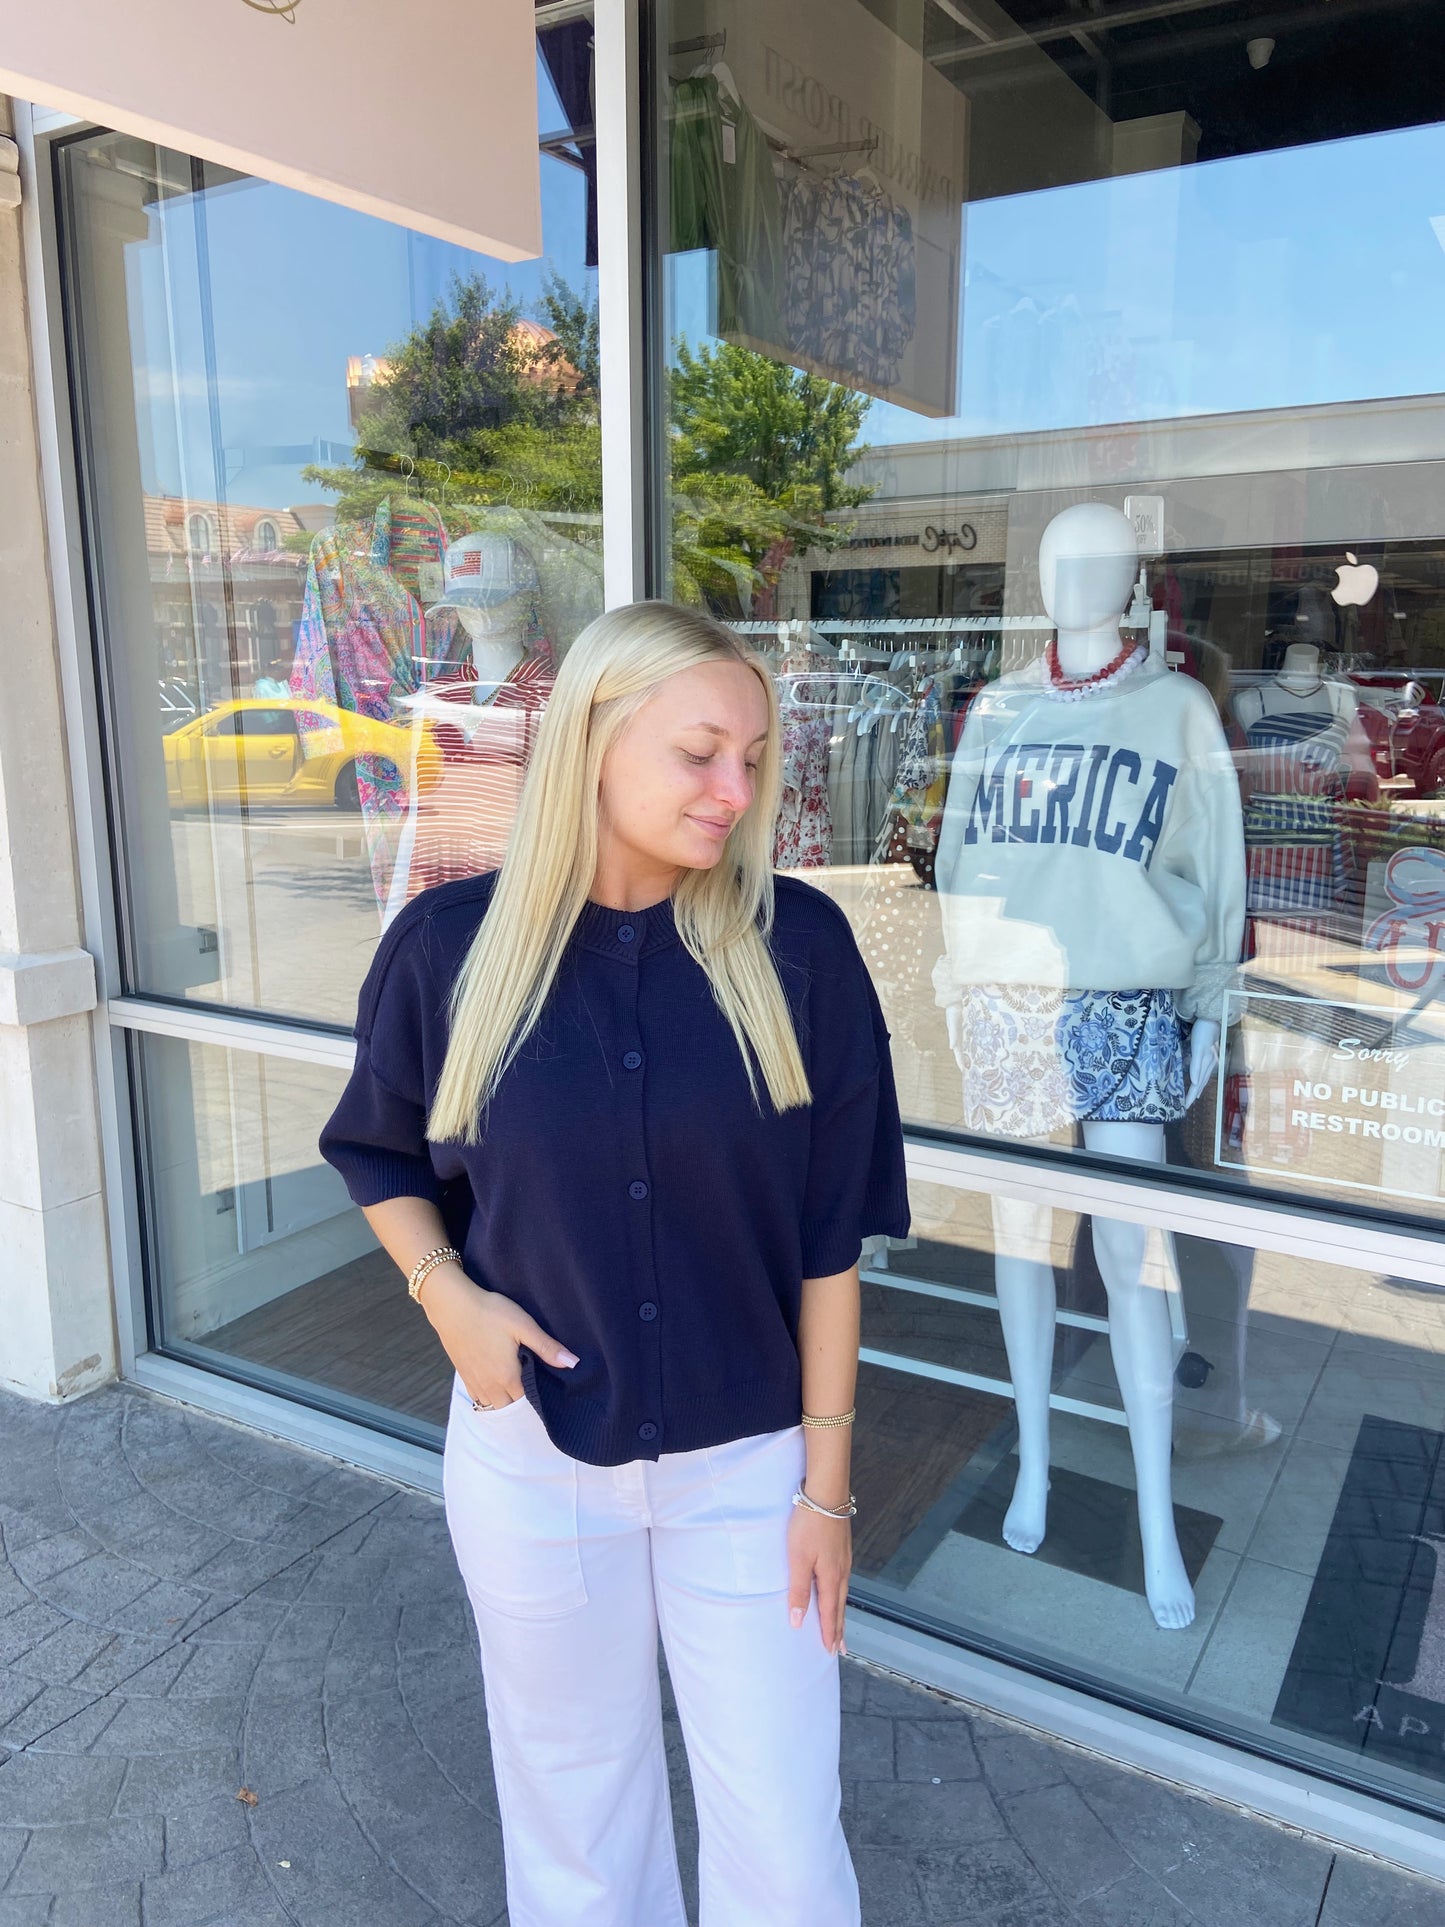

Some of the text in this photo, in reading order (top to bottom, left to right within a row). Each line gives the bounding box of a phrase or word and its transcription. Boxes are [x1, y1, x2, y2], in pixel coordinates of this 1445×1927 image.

[964, 743, 1178, 869] MERICA
[1332, 1038, 1410, 1072] Sorry
[1293, 1079, 1445, 1116] NO PUBLIC
[1291, 1109, 1445, 1148] RESTROOM
